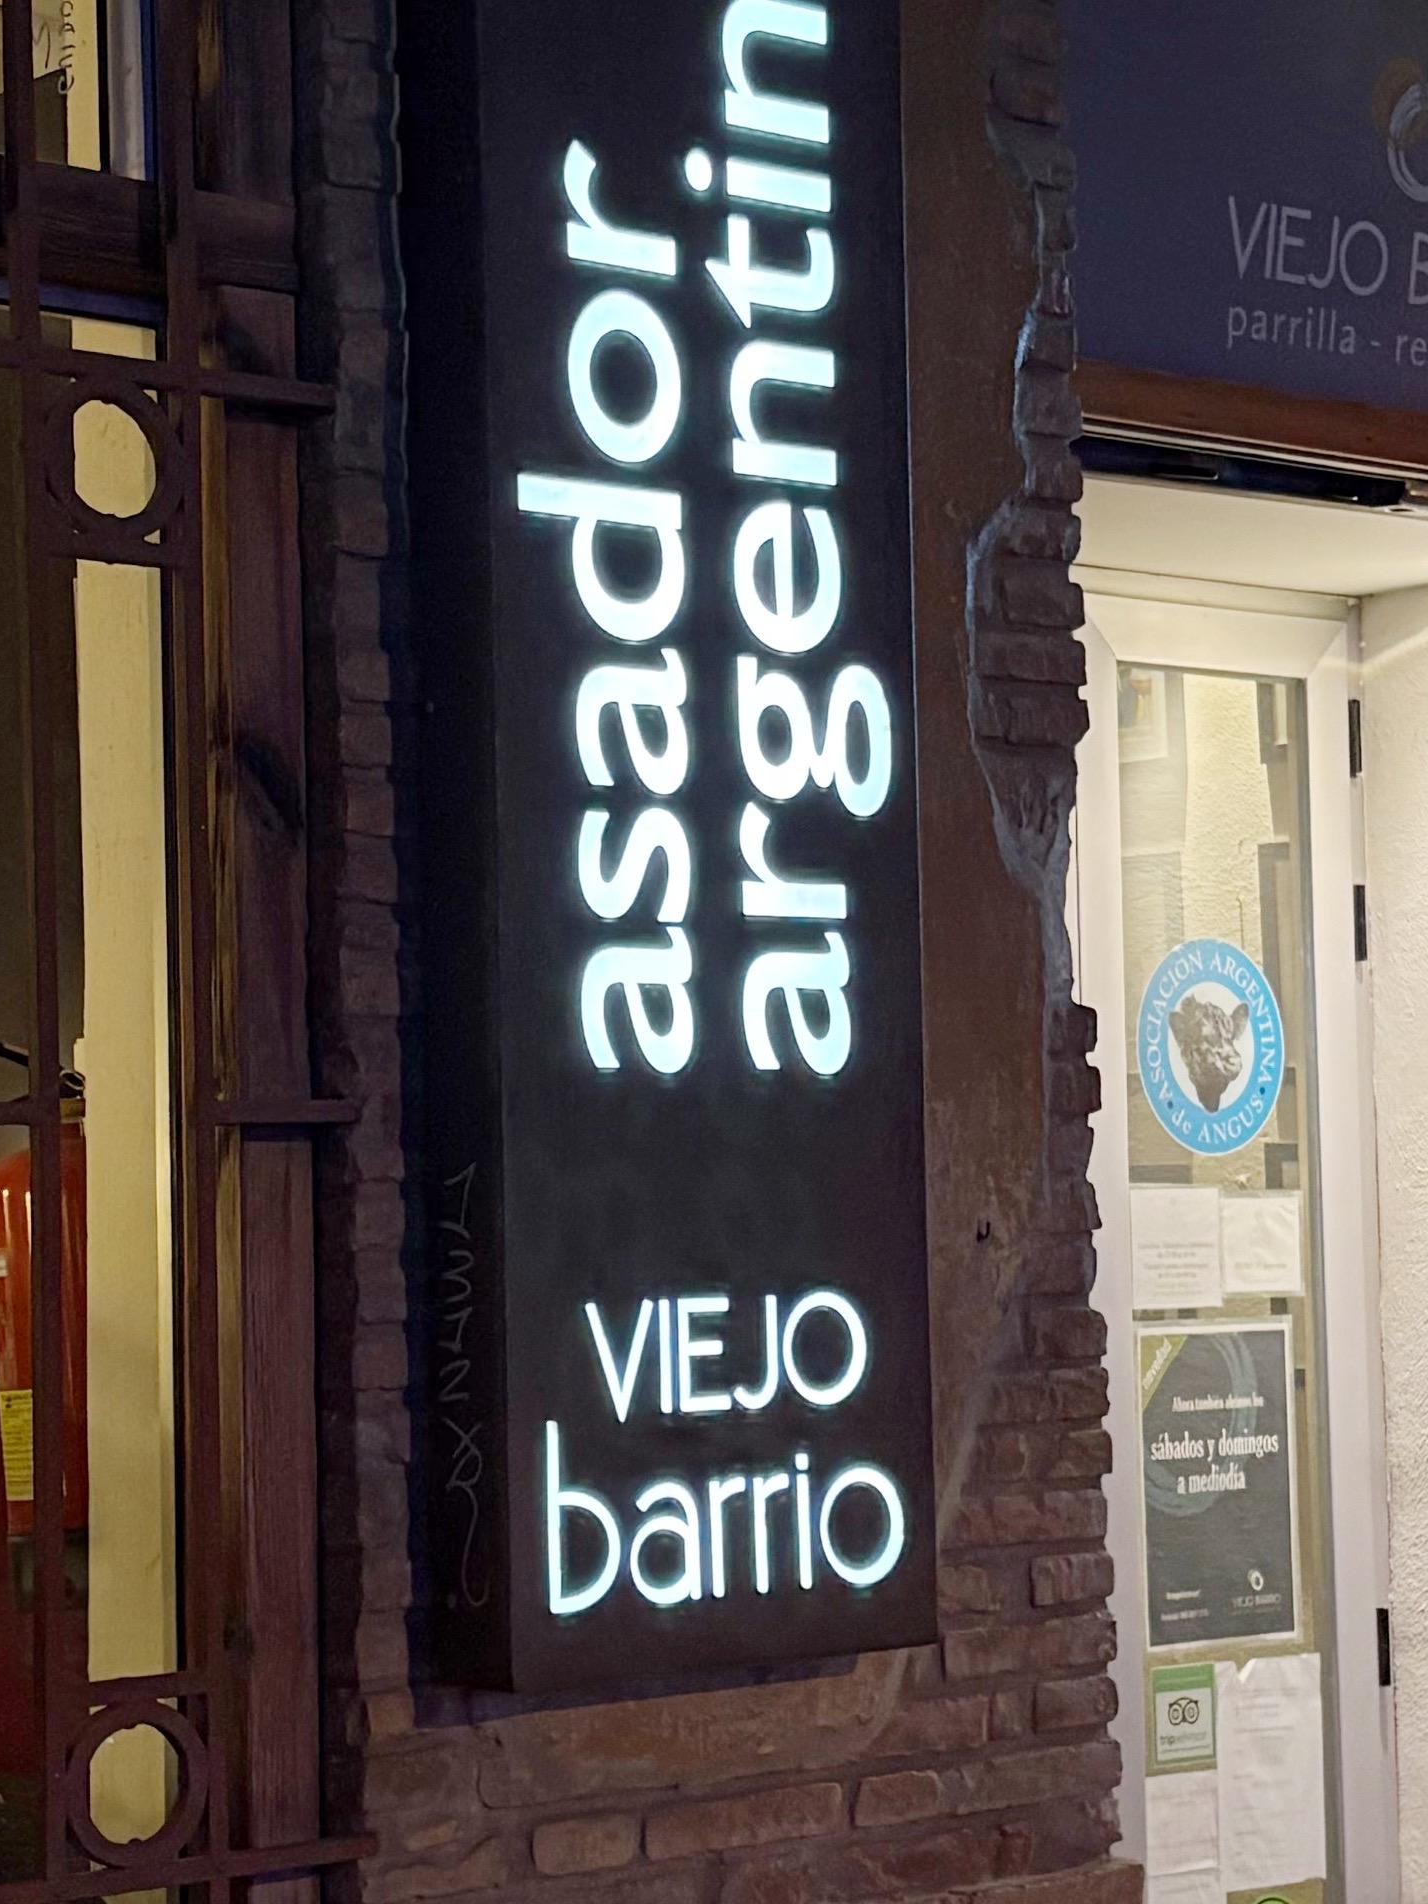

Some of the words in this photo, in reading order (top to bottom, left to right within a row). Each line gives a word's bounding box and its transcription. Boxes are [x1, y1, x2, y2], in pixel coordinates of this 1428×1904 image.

[1227, 196, 1388, 296] VIEJO
[1227, 305, 1357, 355] parrilla
[515, 138, 694, 1074] asador
[1209, 950, 1276, 1084] ARGENTINA
[1172, 1108, 1192, 1135] de
[1198, 1096, 1264, 1145] ANGUS
[585, 1291, 867, 1423] VIEJO
[1150, 1431, 1205, 1461] sábados
[1207, 1439, 1215, 1462] y
[1218, 1428, 1279, 1458] domingos
[1177, 1475, 1186, 1495] a
[1188, 1462, 1247, 1494] mediodía
[546, 1419, 905, 1614] barrio
